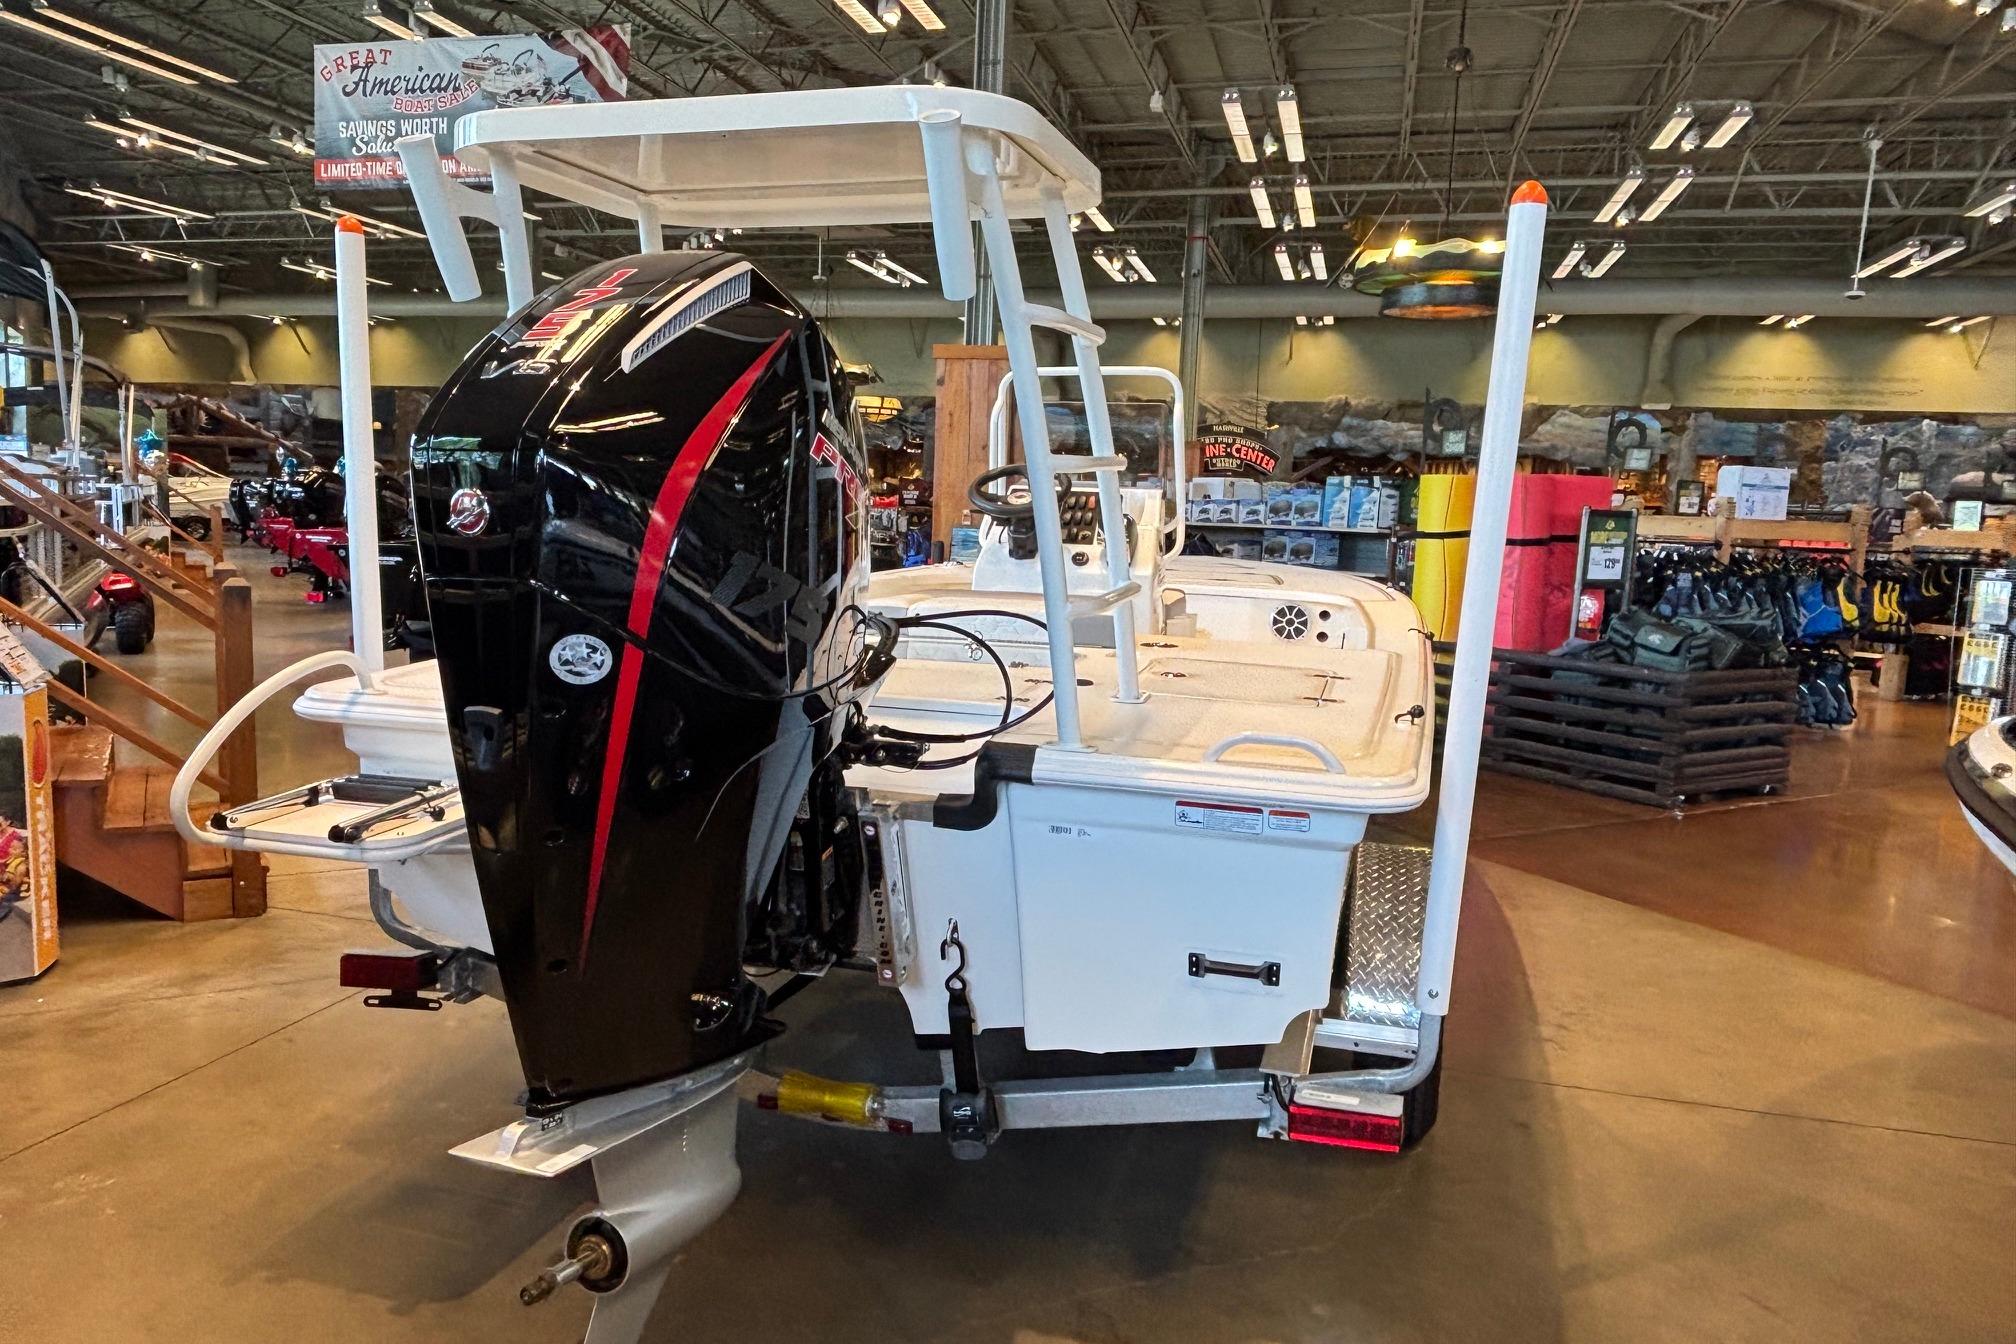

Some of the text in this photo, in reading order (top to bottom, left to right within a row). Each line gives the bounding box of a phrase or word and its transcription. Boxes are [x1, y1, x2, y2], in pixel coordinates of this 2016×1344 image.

[320, 48, 392, 82] GREAT
[341, 61, 462, 98] American
[393, 79, 479, 112] BOAT SALE
[339, 117, 448, 138] SAVINGS WORTH
[320, 160, 394, 178] LIMITED-TIME
[441, 159, 457, 174] ON
[1205, 443, 1276, 474] INE CENTER
